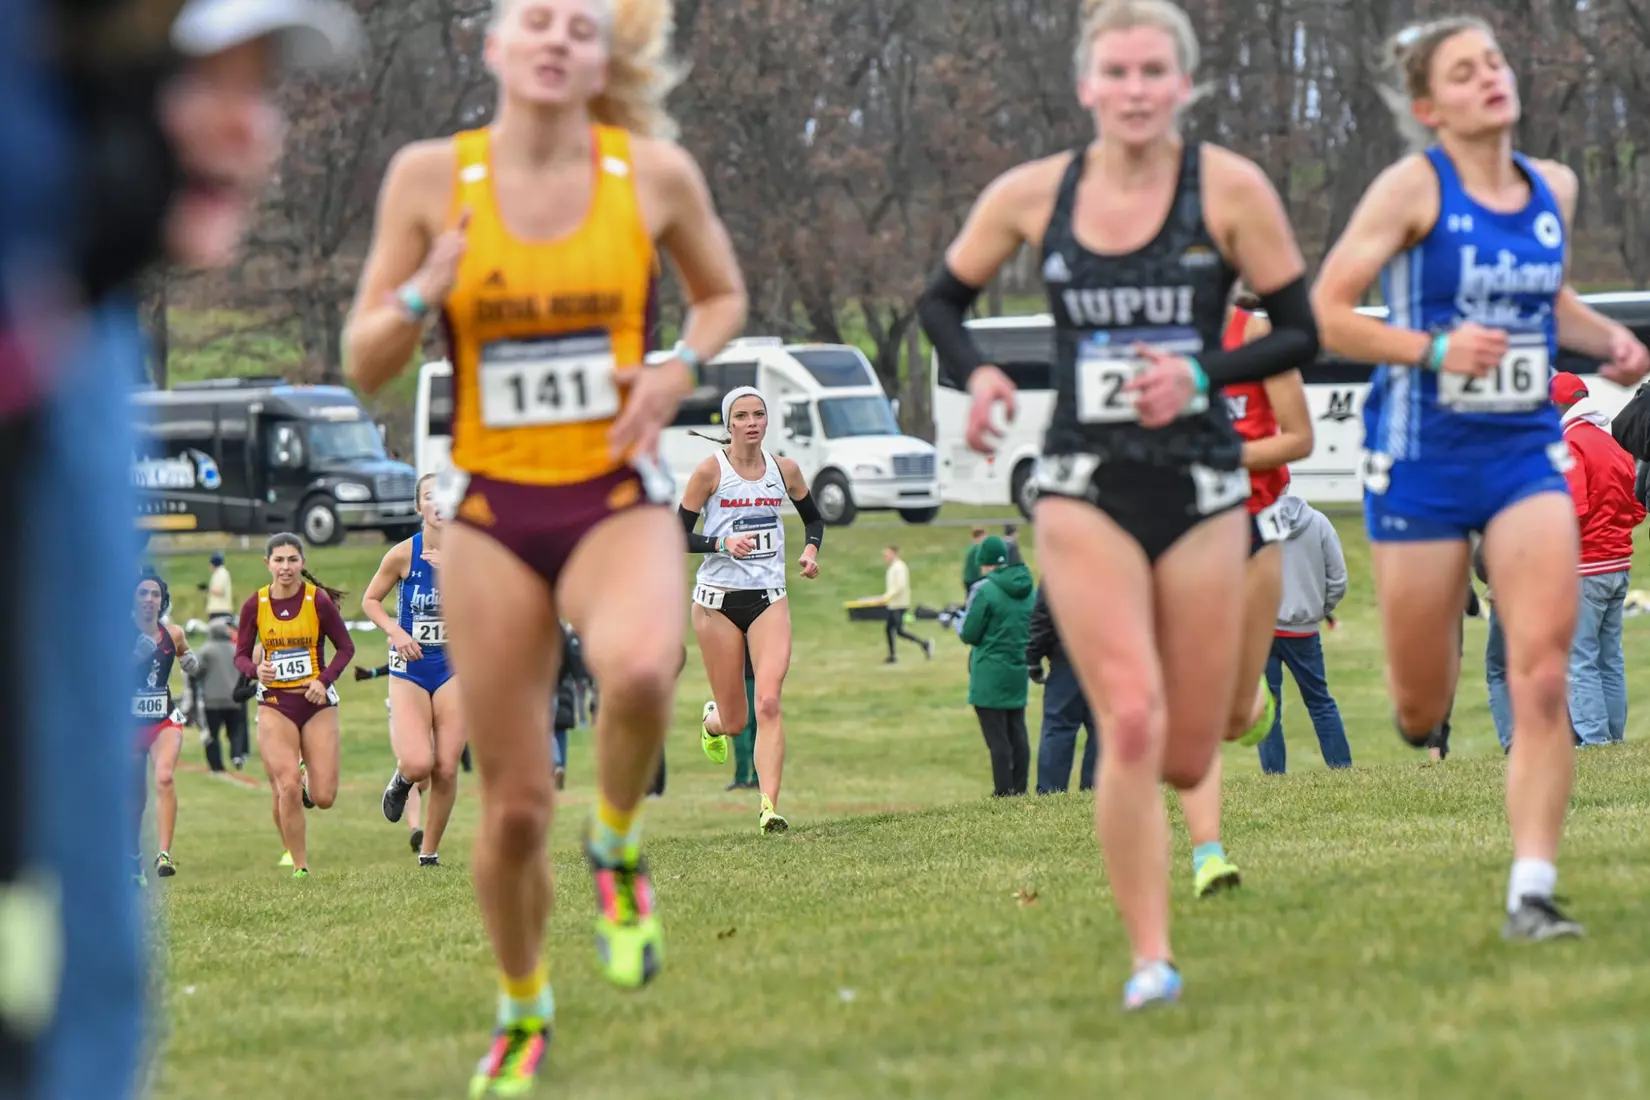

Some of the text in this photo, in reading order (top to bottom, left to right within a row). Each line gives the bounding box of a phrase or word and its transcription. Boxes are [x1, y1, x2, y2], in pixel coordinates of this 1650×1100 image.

[1062, 286, 1195, 326] IUPUI
[504, 368, 588, 412] 141
[1101, 372, 1124, 408] 2
[720, 498, 752, 507] BALL
[277, 660, 305, 676] 145
[137, 699, 162, 712] 406
